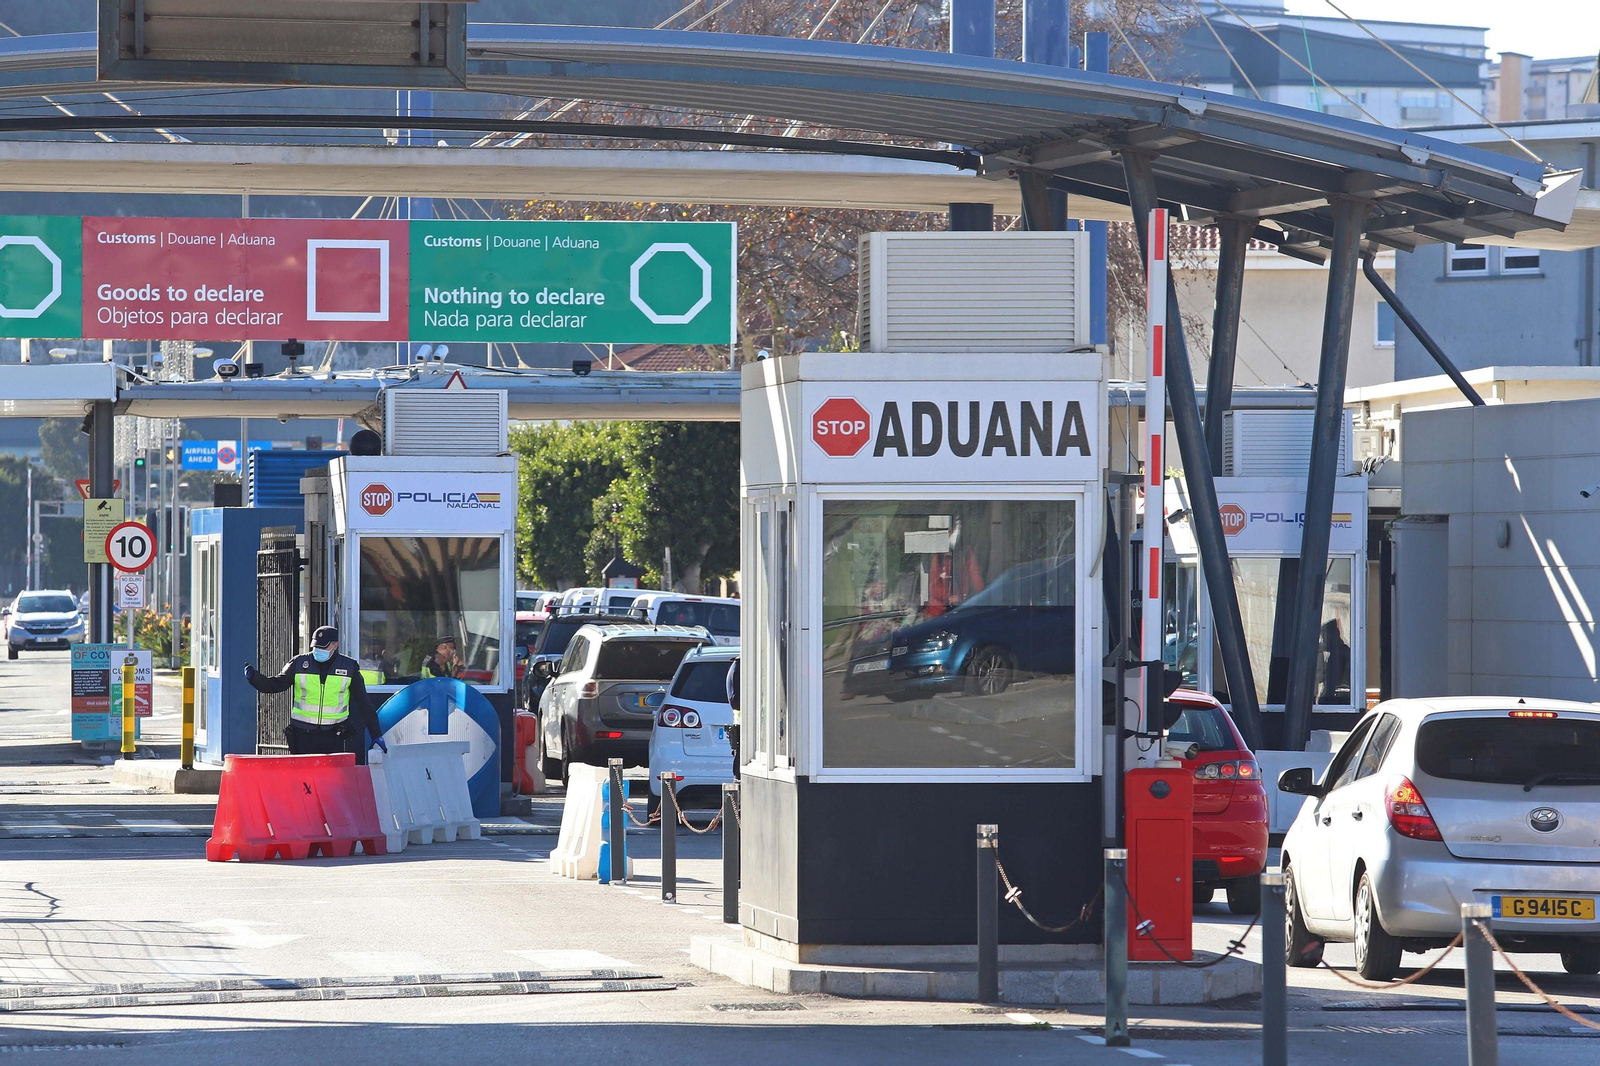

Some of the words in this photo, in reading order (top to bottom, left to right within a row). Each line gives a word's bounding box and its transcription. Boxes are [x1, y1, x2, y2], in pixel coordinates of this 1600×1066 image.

[97, 231, 156, 245] Customs
[167, 232, 216, 246] Douane
[227, 233, 276, 246] Aduana
[424, 235, 482, 248] Customs
[493, 235, 541, 248] Douane
[552, 236, 600, 249] Aduana
[97, 284, 161, 301] Goods
[166, 285, 188, 301] to
[193, 284, 265, 302] declare
[424, 287, 502, 308] Nothing
[508, 290, 530, 305] to
[535, 288, 605, 305] declare
[97, 306, 165, 328] Objetos
[170, 311, 209, 328] para
[215, 307, 284, 326] declarar
[424, 311, 469, 327] Nada
[476, 313, 513, 331] para
[519, 310, 587, 328] declarar
[816, 420, 866, 436] STOP
[873, 400, 1092, 458] ADUANA
[185, 447, 216, 455] AIRFIELD
[363, 492, 391, 507] STOP
[1250, 512, 1306, 523] POLIC
[115, 535, 147, 559] 10
[74, 651, 87, 660] OF
[112, 667, 150, 675] CUOMS
